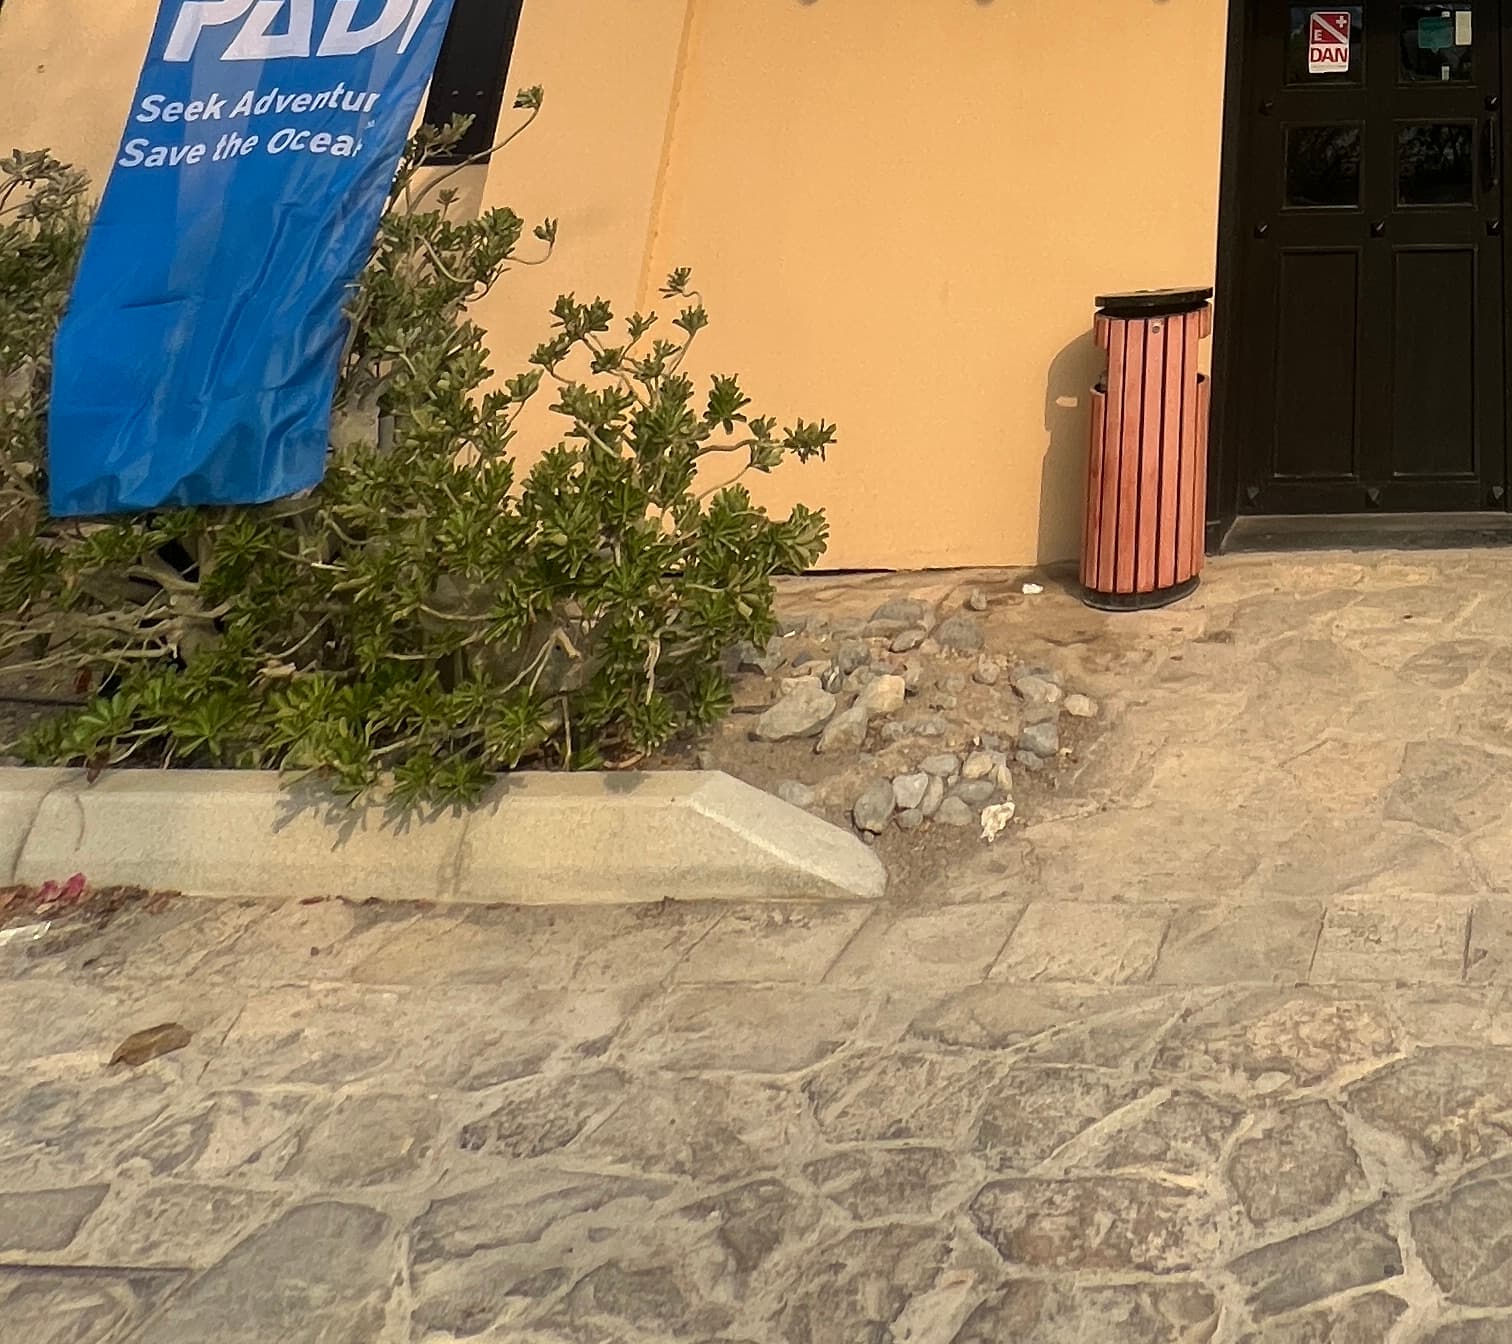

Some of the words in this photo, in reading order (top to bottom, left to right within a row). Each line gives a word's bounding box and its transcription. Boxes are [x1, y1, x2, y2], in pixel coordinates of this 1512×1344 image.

[1310, 47, 1348, 63] DAN
[136, 93, 228, 124] Seek
[229, 81, 381, 119] Adventur
[118, 138, 207, 168] Save
[211, 131, 259, 162] the
[266, 127, 364, 158] Ocea
